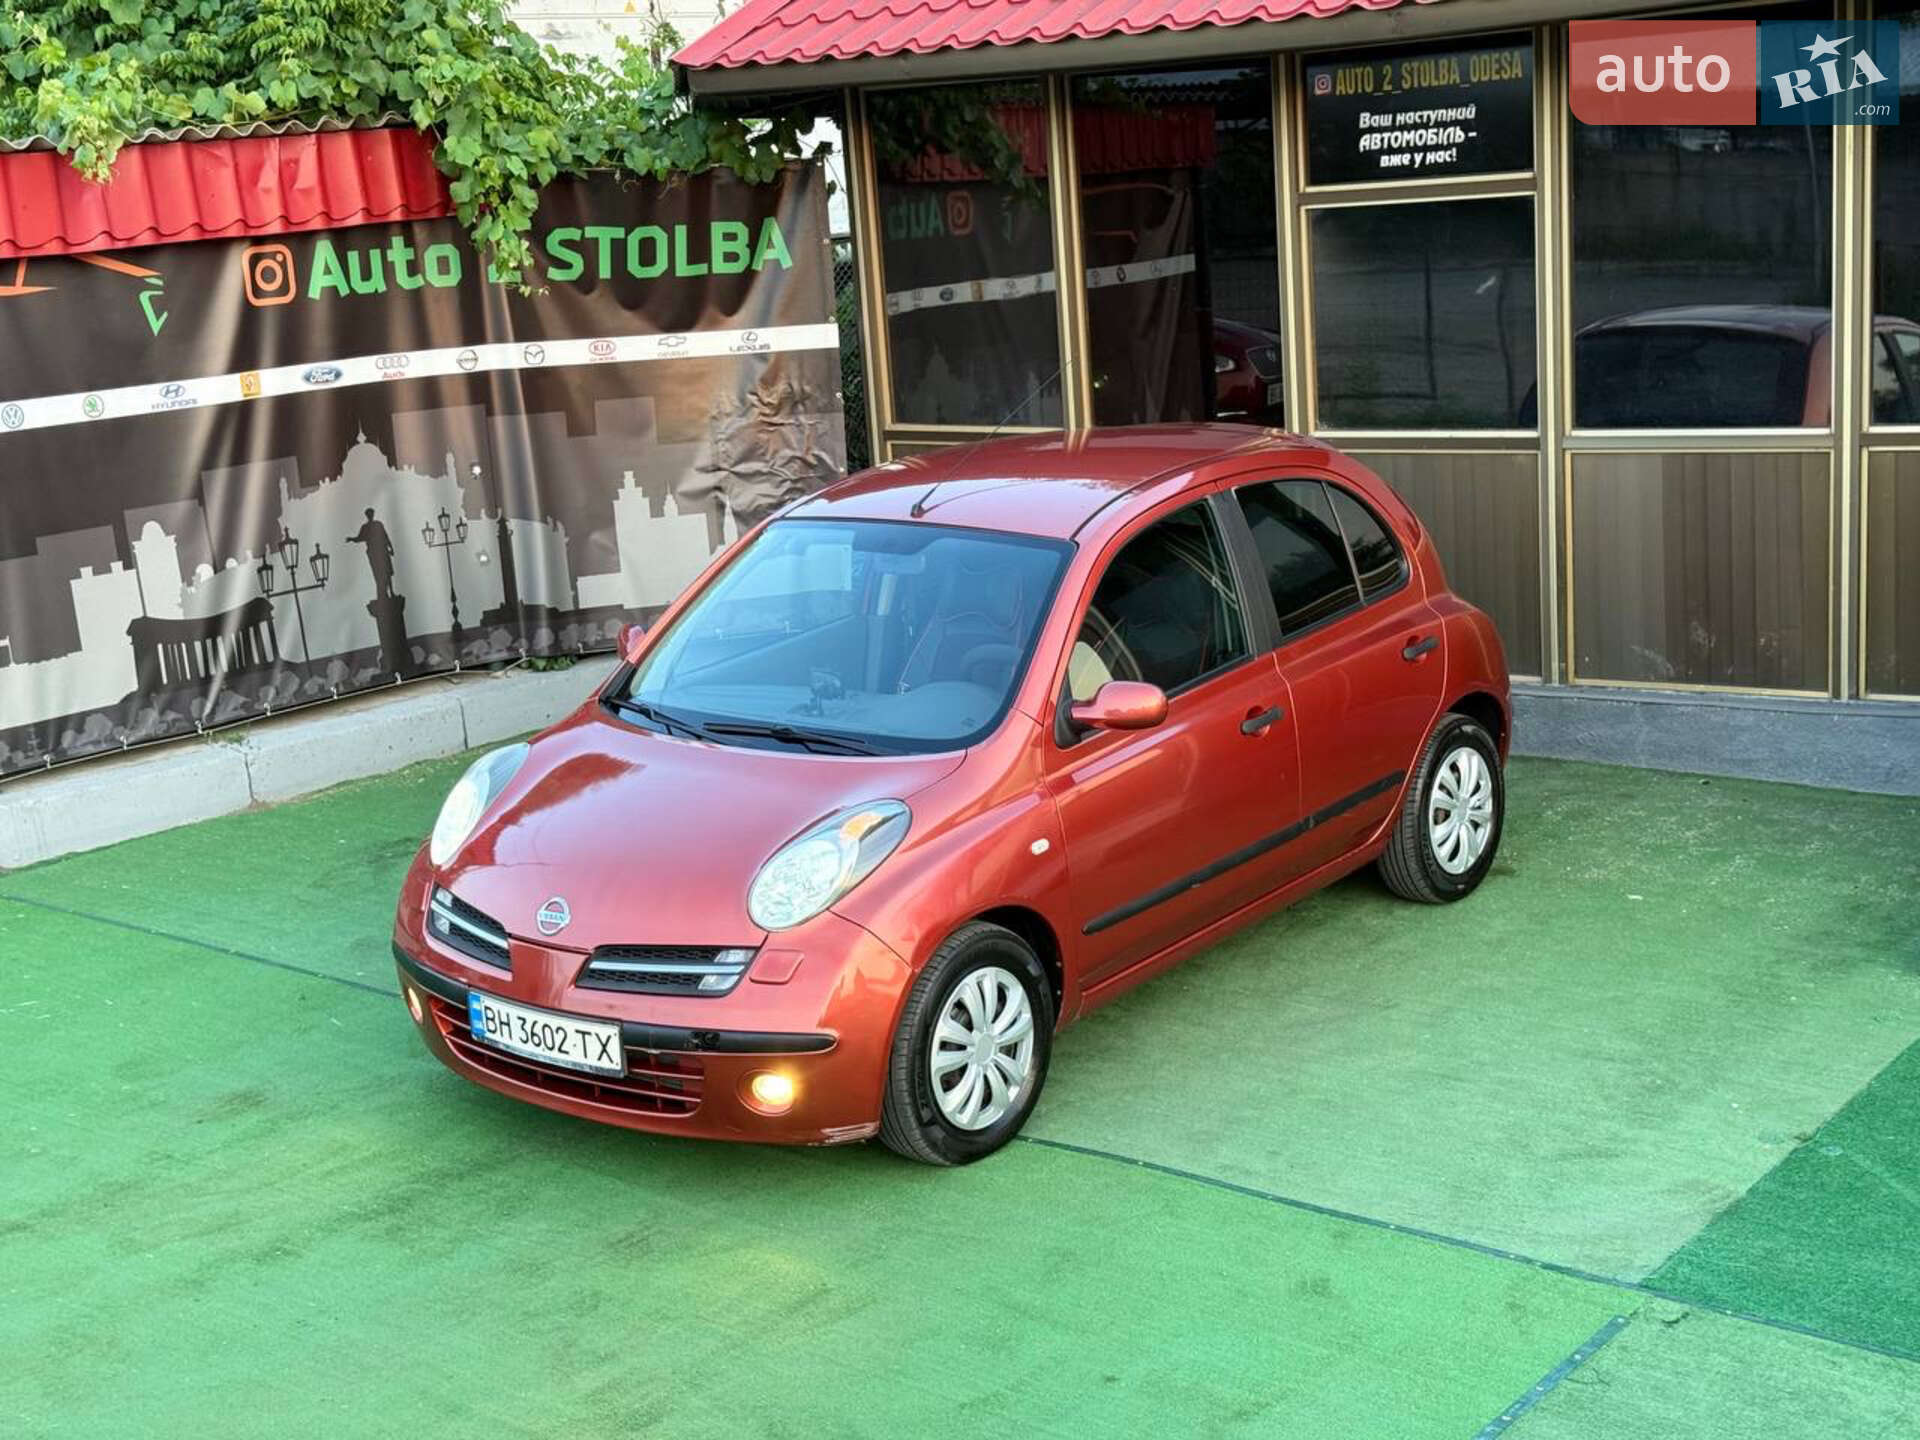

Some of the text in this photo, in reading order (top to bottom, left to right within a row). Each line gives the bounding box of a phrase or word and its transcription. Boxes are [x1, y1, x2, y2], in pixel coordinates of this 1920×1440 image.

[1359, 103, 1476, 129] Ваш наступний
[1380, 147, 1457, 168] вже у нас!
[307, 216, 792, 300] Auto STOLBA
[593, 343, 613, 353] KIA
[484, 1005, 614, 1064] BH 3602 TX
